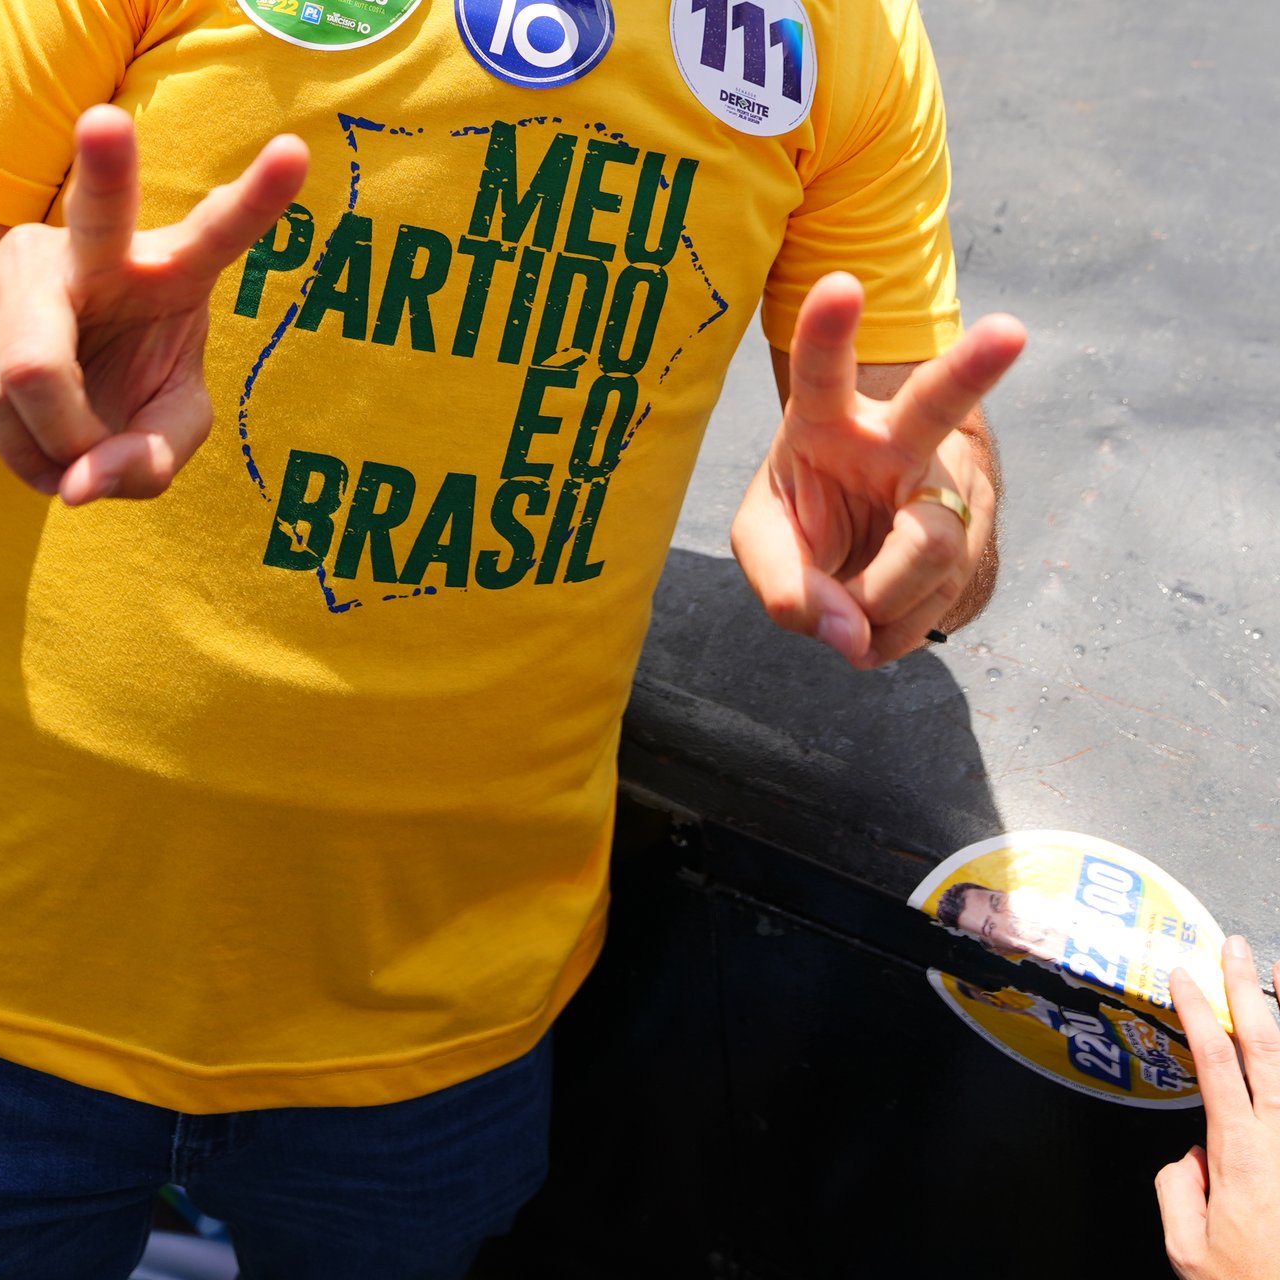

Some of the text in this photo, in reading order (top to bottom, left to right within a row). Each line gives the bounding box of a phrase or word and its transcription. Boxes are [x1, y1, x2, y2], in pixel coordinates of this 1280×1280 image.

[305, 6, 319, 19] PL
[357, 21, 371, 34] 10
[720, 89, 769, 118] DERRITE
[467, 120, 699, 267] MEU
[234, 202, 669, 377] PARTIDO
[568, 374, 639, 482] O
[262, 449, 605, 590] BRASIL
